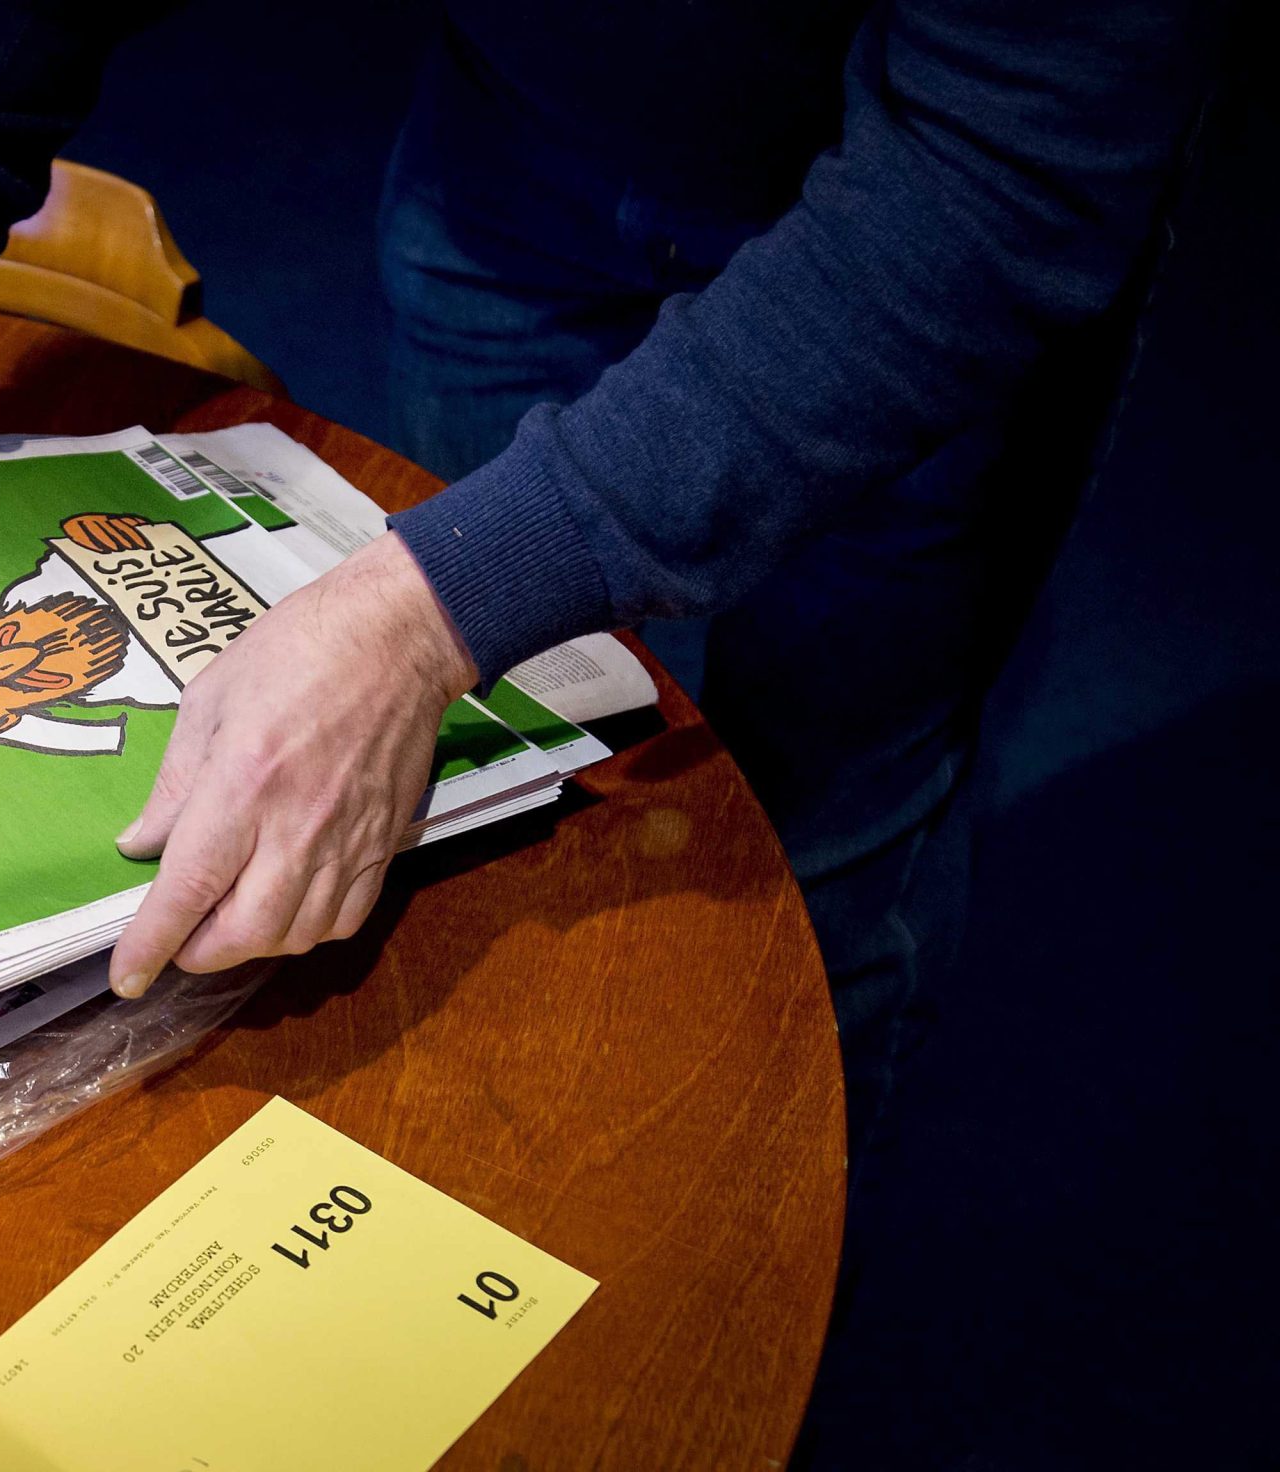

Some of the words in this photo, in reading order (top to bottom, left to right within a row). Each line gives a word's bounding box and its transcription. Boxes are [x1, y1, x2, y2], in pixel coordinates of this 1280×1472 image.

[94, 558, 185, 621] SUIS
[150, 545, 257, 641] HARLIE
[165, 619, 223, 662] JE
[241, 1137, 275, 1167] 055069
[270, 1185, 372, 1270] 0311
[145, 1252, 243, 1343] KONINGSPLEIN
[149, 1240, 224, 1309] AMSTERDAM
[186, 1264, 261, 1331] SCHELTEMA
[457, 1271, 519, 1320] 01
[123, 1344, 144, 1364] 20
